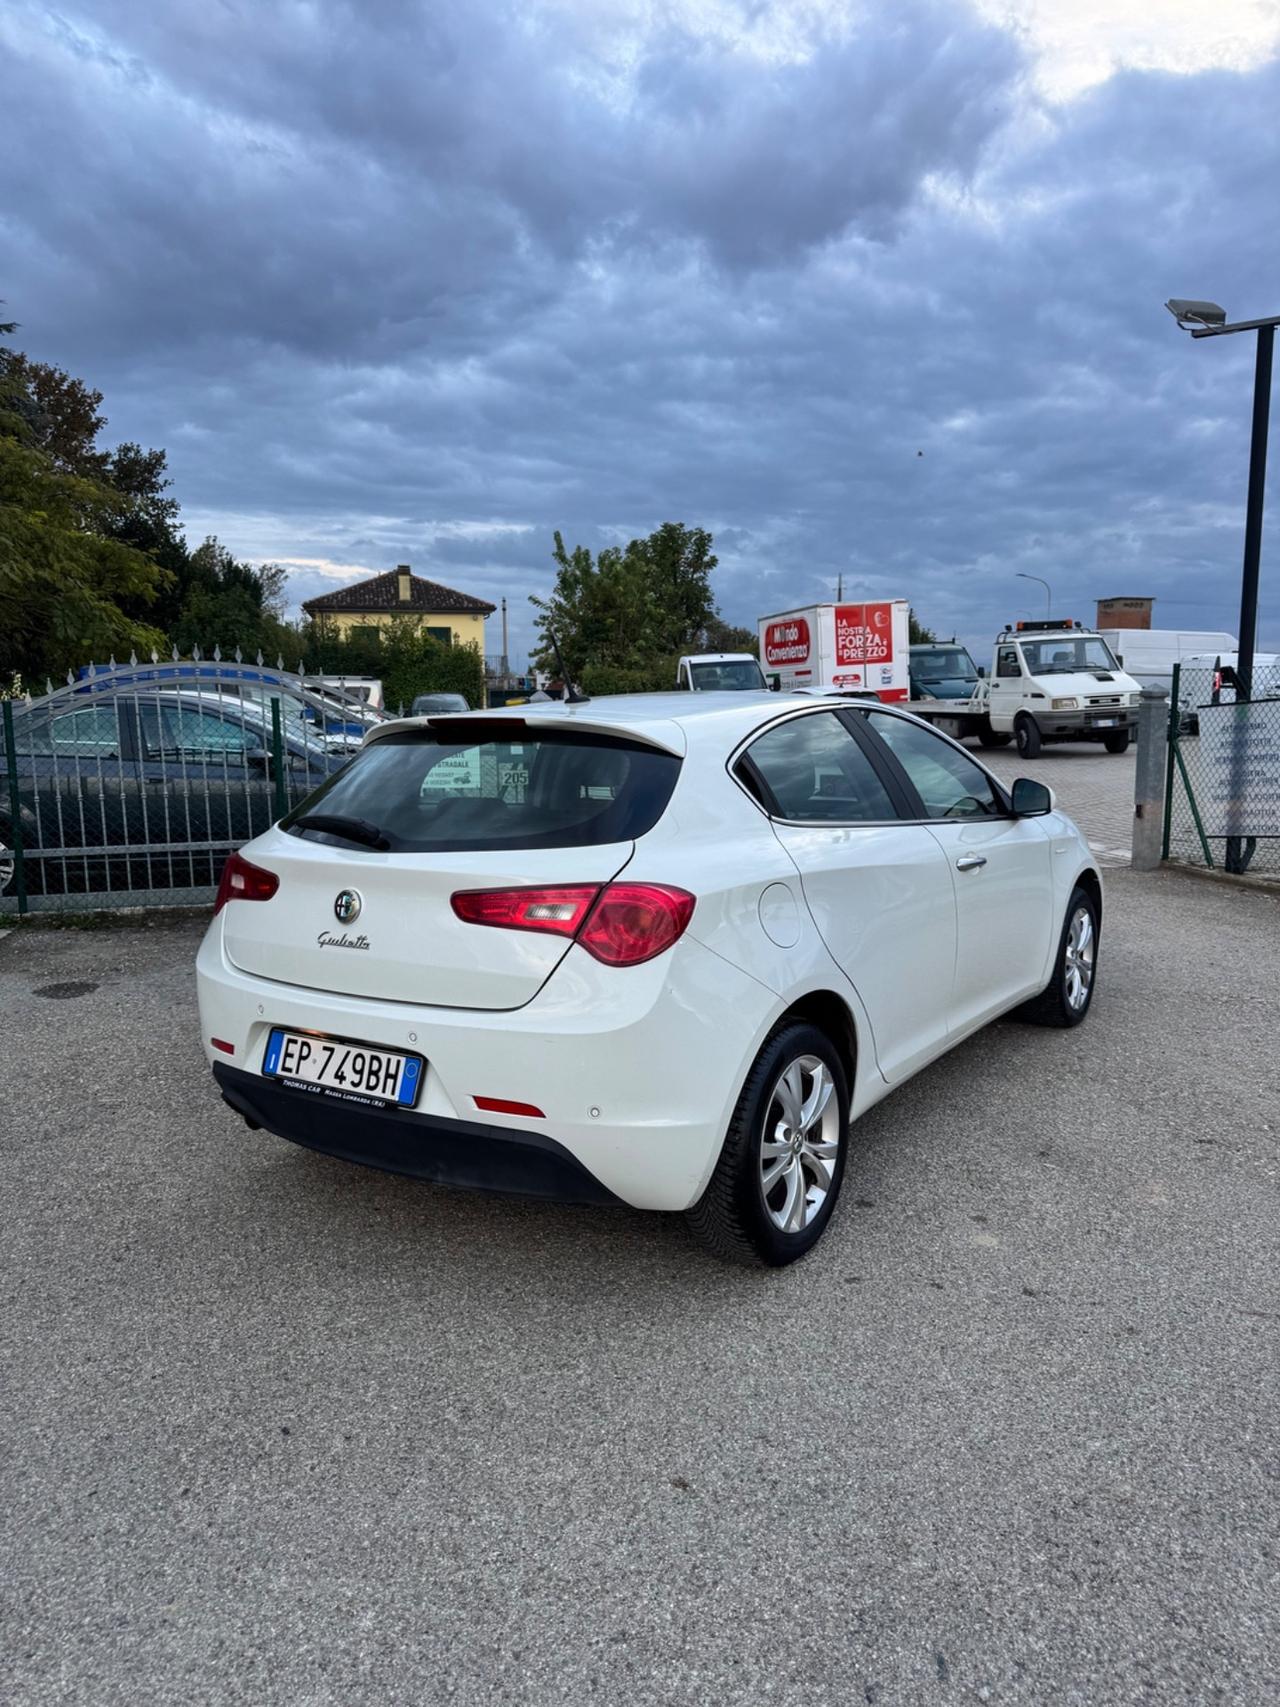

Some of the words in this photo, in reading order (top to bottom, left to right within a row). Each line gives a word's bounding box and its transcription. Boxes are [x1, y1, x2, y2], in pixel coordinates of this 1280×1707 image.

[837, 619, 848, 627] LA
[837, 626, 871, 636] NOSTRA
[838, 633, 882, 649] FORZA
[843, 646, 888, 659] PREZZO
[504, 772, 528, 785] 205
[281, 1038, 312, 1075] EP
[317, 1046, 401, 1096] 749BH
[282, 1079, 307, 1091] THOMAS
[307, 1085, 321, 1094] CAR
